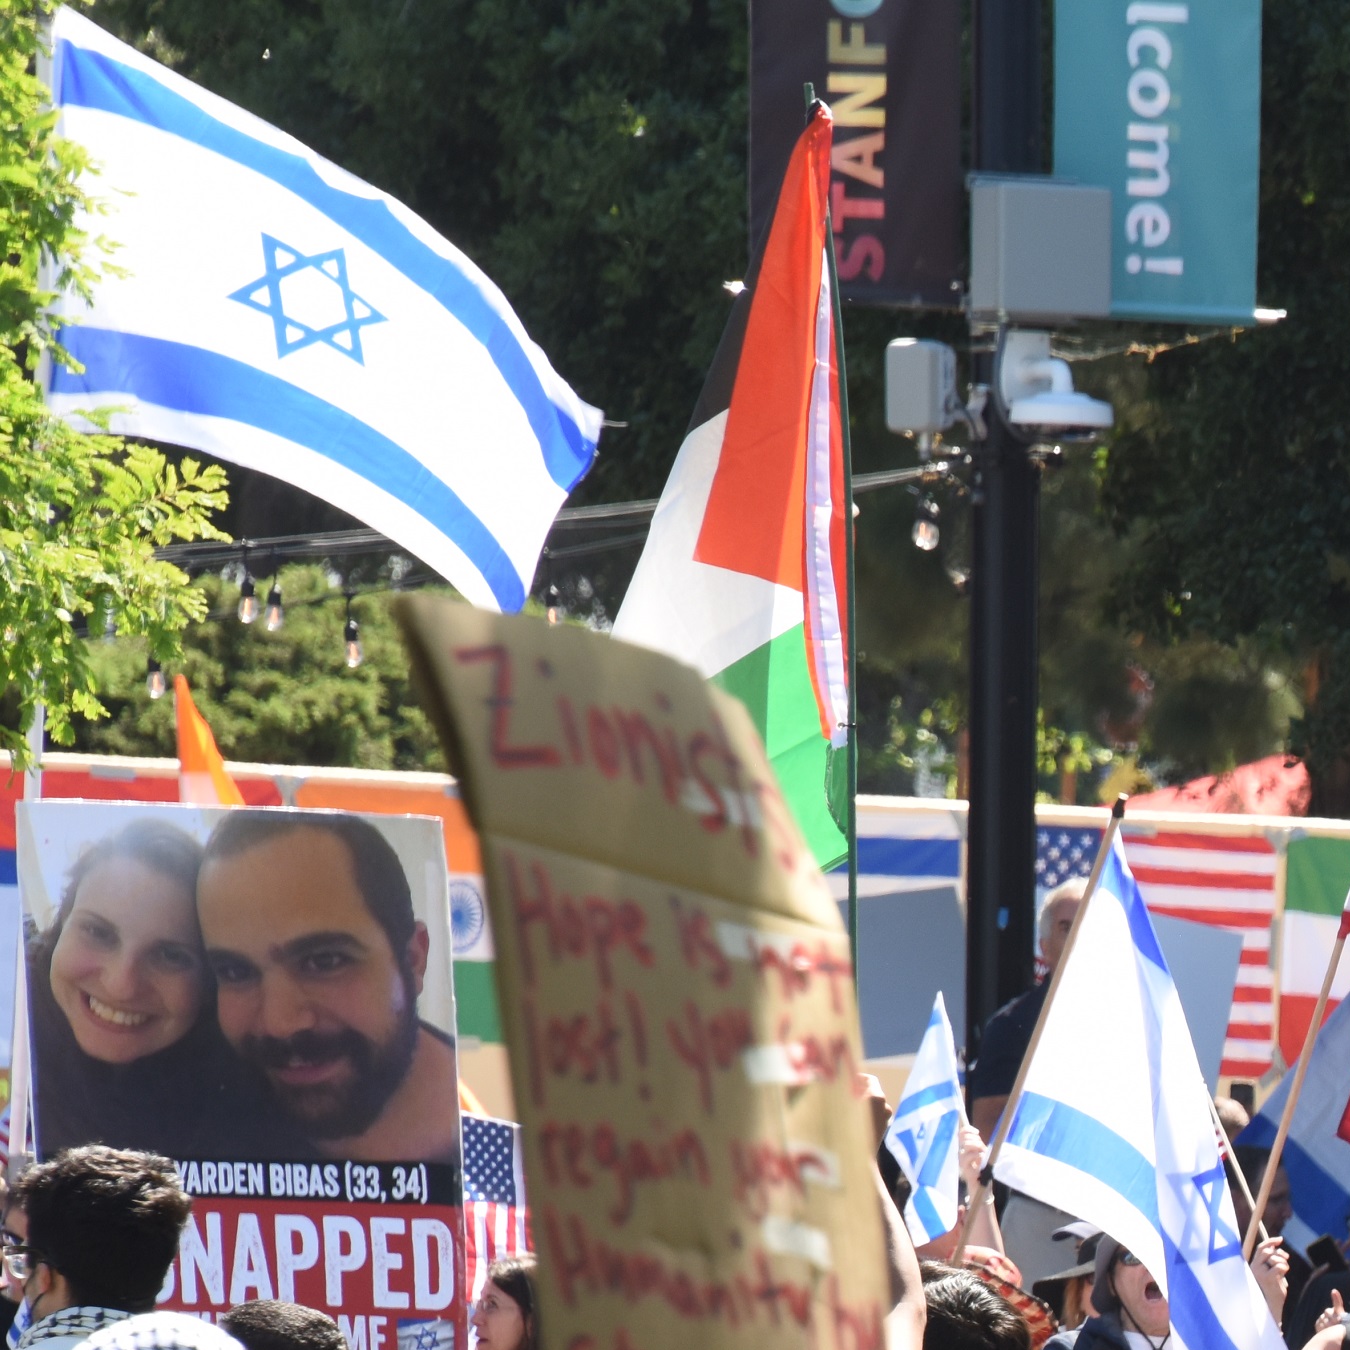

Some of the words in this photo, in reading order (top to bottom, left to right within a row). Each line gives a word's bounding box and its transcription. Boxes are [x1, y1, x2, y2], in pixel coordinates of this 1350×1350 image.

[174, 1160, 264, 1195] YARDEN
[269, 1162, 340, 1198] BIBAS
[344, 1160, 387, 1203] (33,
[391, 1162, 429, 1205] 34)
[158, 1211, 454, 1311] NAPPED
